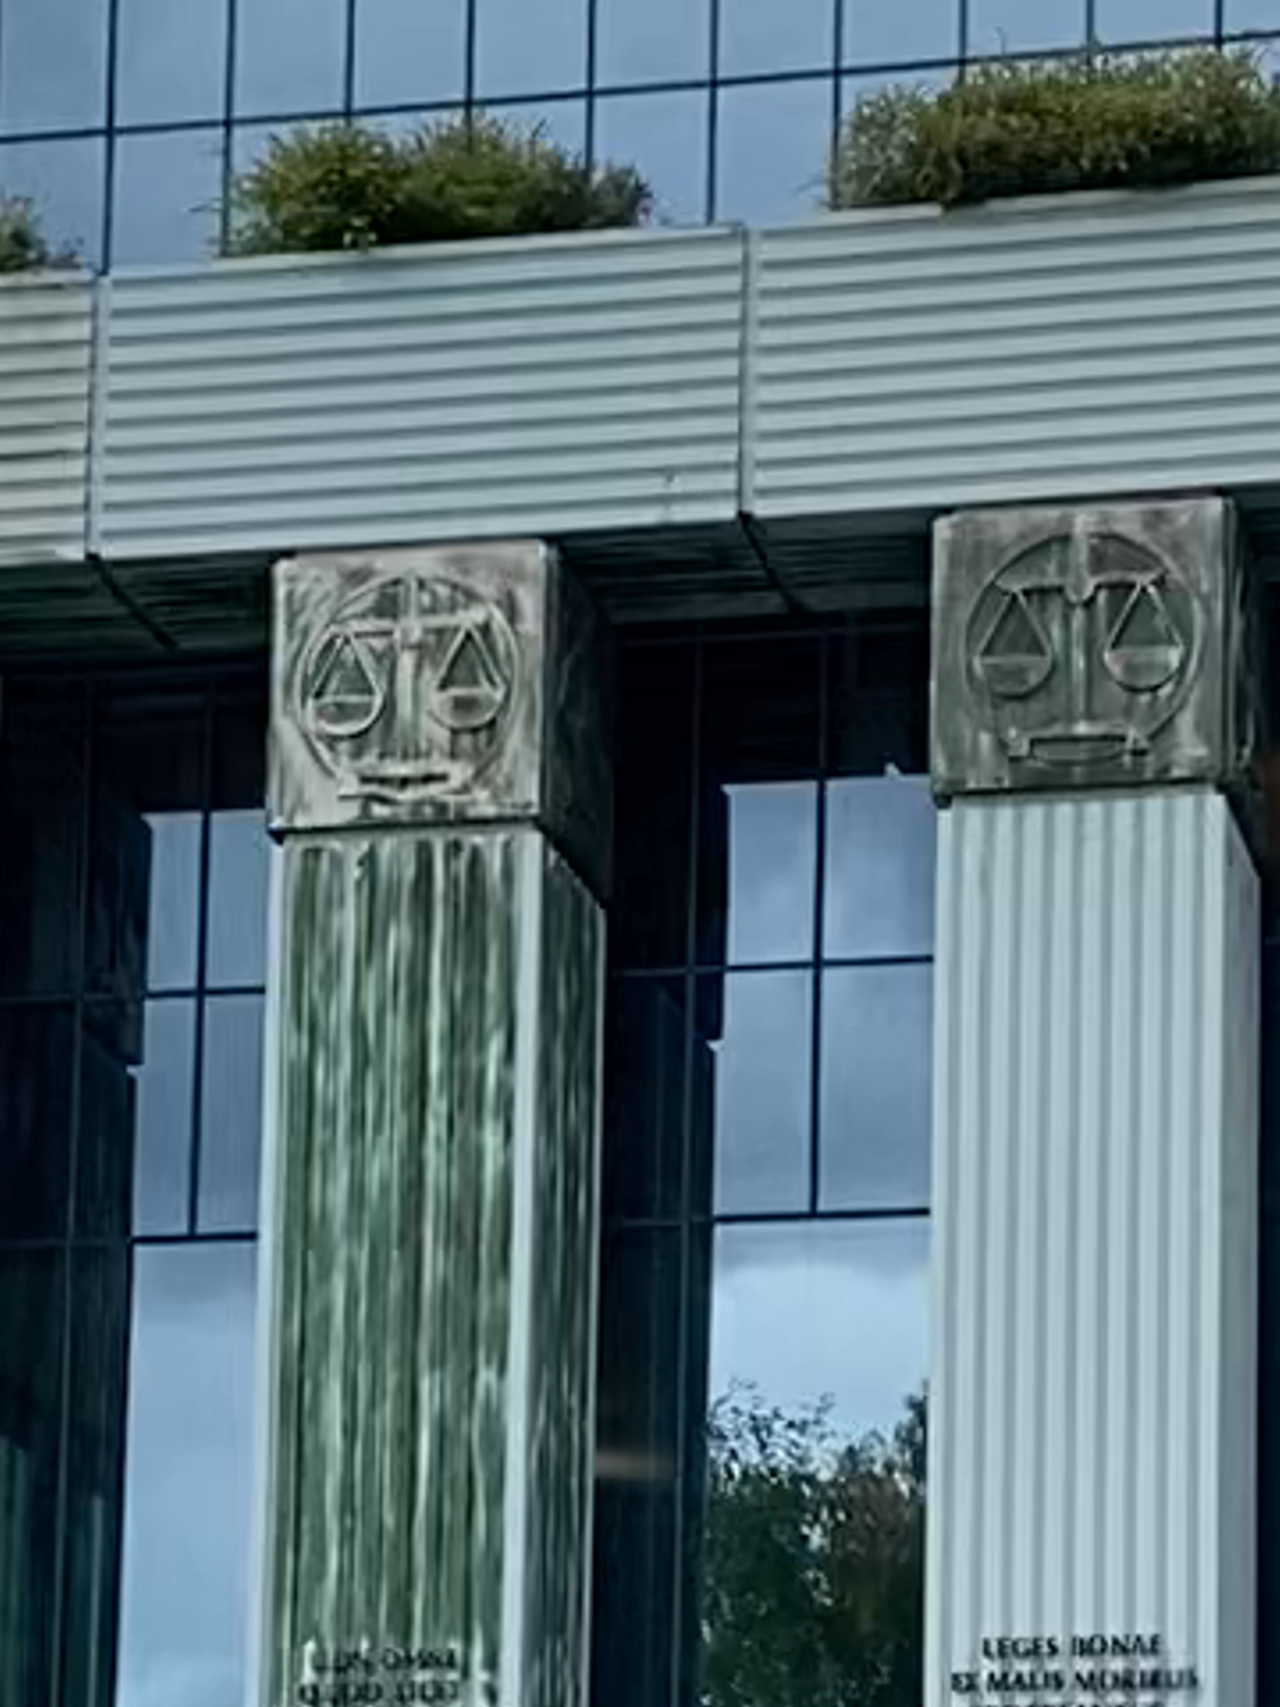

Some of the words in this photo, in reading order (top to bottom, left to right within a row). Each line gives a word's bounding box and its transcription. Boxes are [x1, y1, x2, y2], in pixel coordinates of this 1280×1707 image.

[982, 1637, 1059, 1660] LEGES
[1071, 1634, 1160, 1659] BONAE
[951, 1672, 978, 1693] EX
[987, 1670, 1064, 1692] MALIS
[1075, 1669, 1198, 1693] MORIBUS
